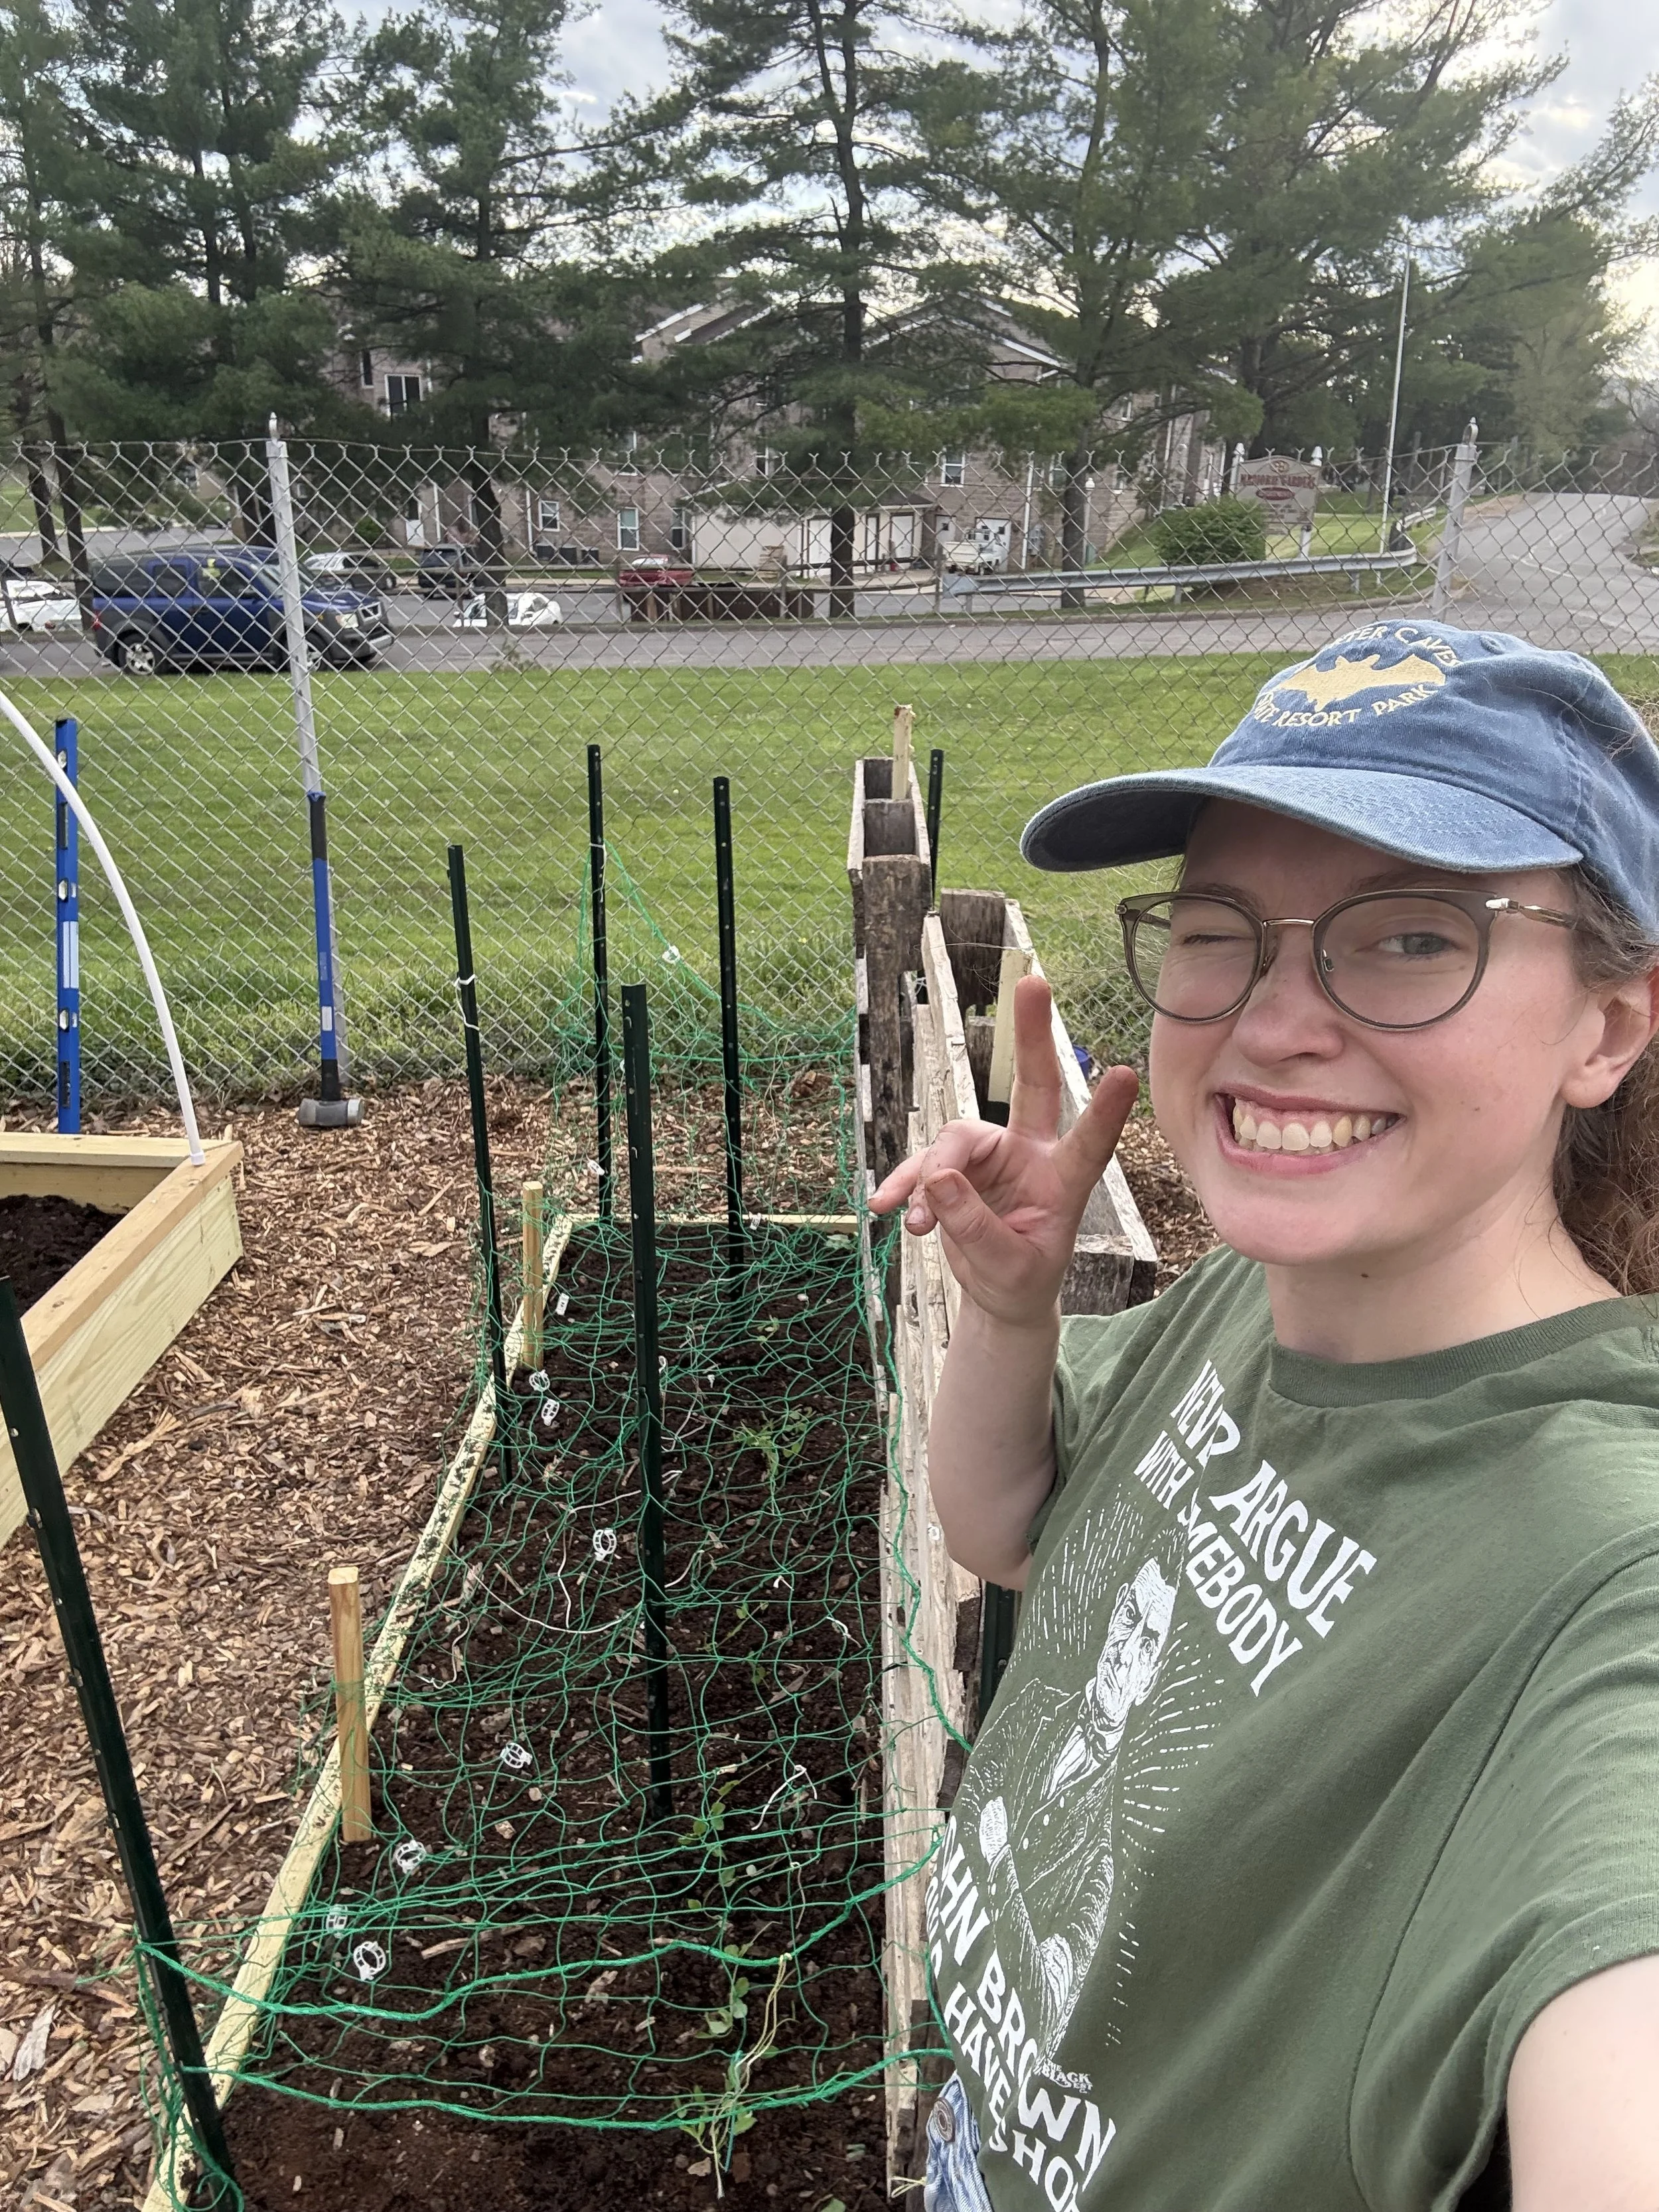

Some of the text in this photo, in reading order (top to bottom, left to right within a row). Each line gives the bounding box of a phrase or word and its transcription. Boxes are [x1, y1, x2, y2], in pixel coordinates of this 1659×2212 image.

[1271, 708, 1362, 727] RESORT
[1372, 684, 1439, 716] PARK
[1133, 1430, 1195, 1510] WITH
[1208, 1459, 1377, 1639] ARGUE
[940, 1814, 991, 1966] OHN
[944, 1982, 1011, 2126] HAVE
[1041, 2061, 1091, 2089] BLACK
